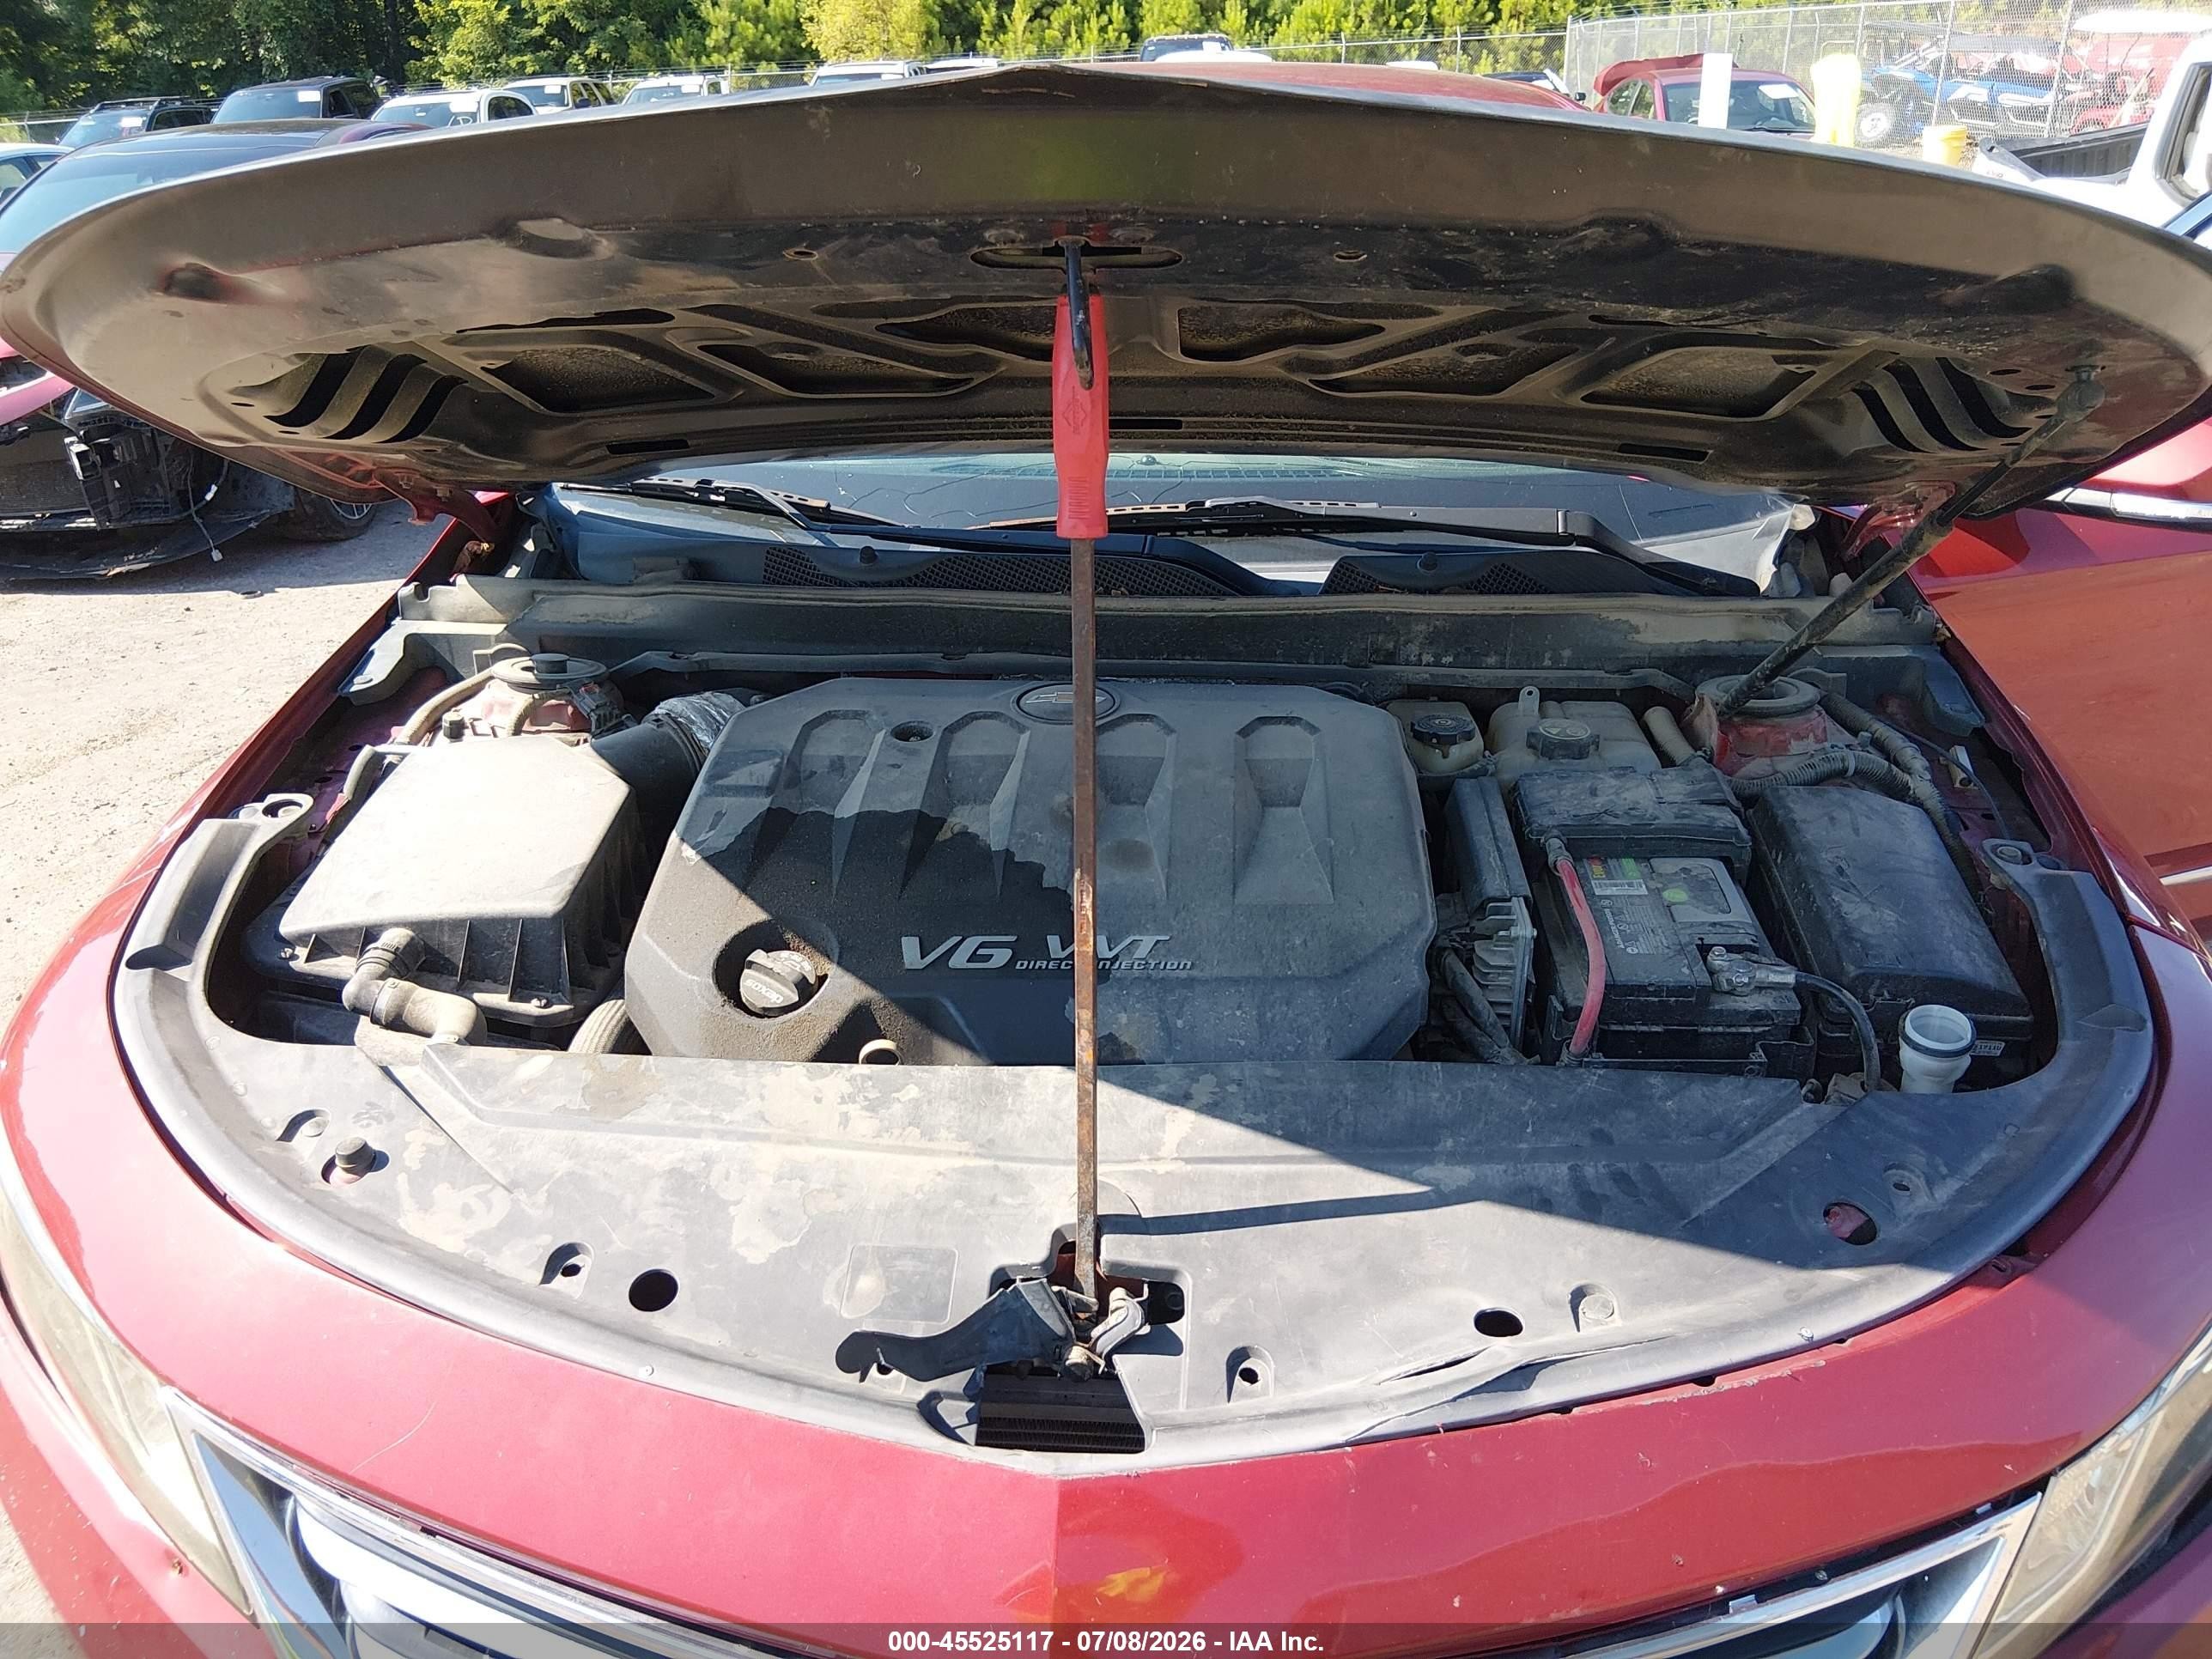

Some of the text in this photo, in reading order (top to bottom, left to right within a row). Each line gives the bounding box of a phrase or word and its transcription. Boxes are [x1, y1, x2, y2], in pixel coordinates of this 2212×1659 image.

[902, 934, 1170, 969] V6 VVT
[1015, 960, 1192, 969] DIREC NJECTION
